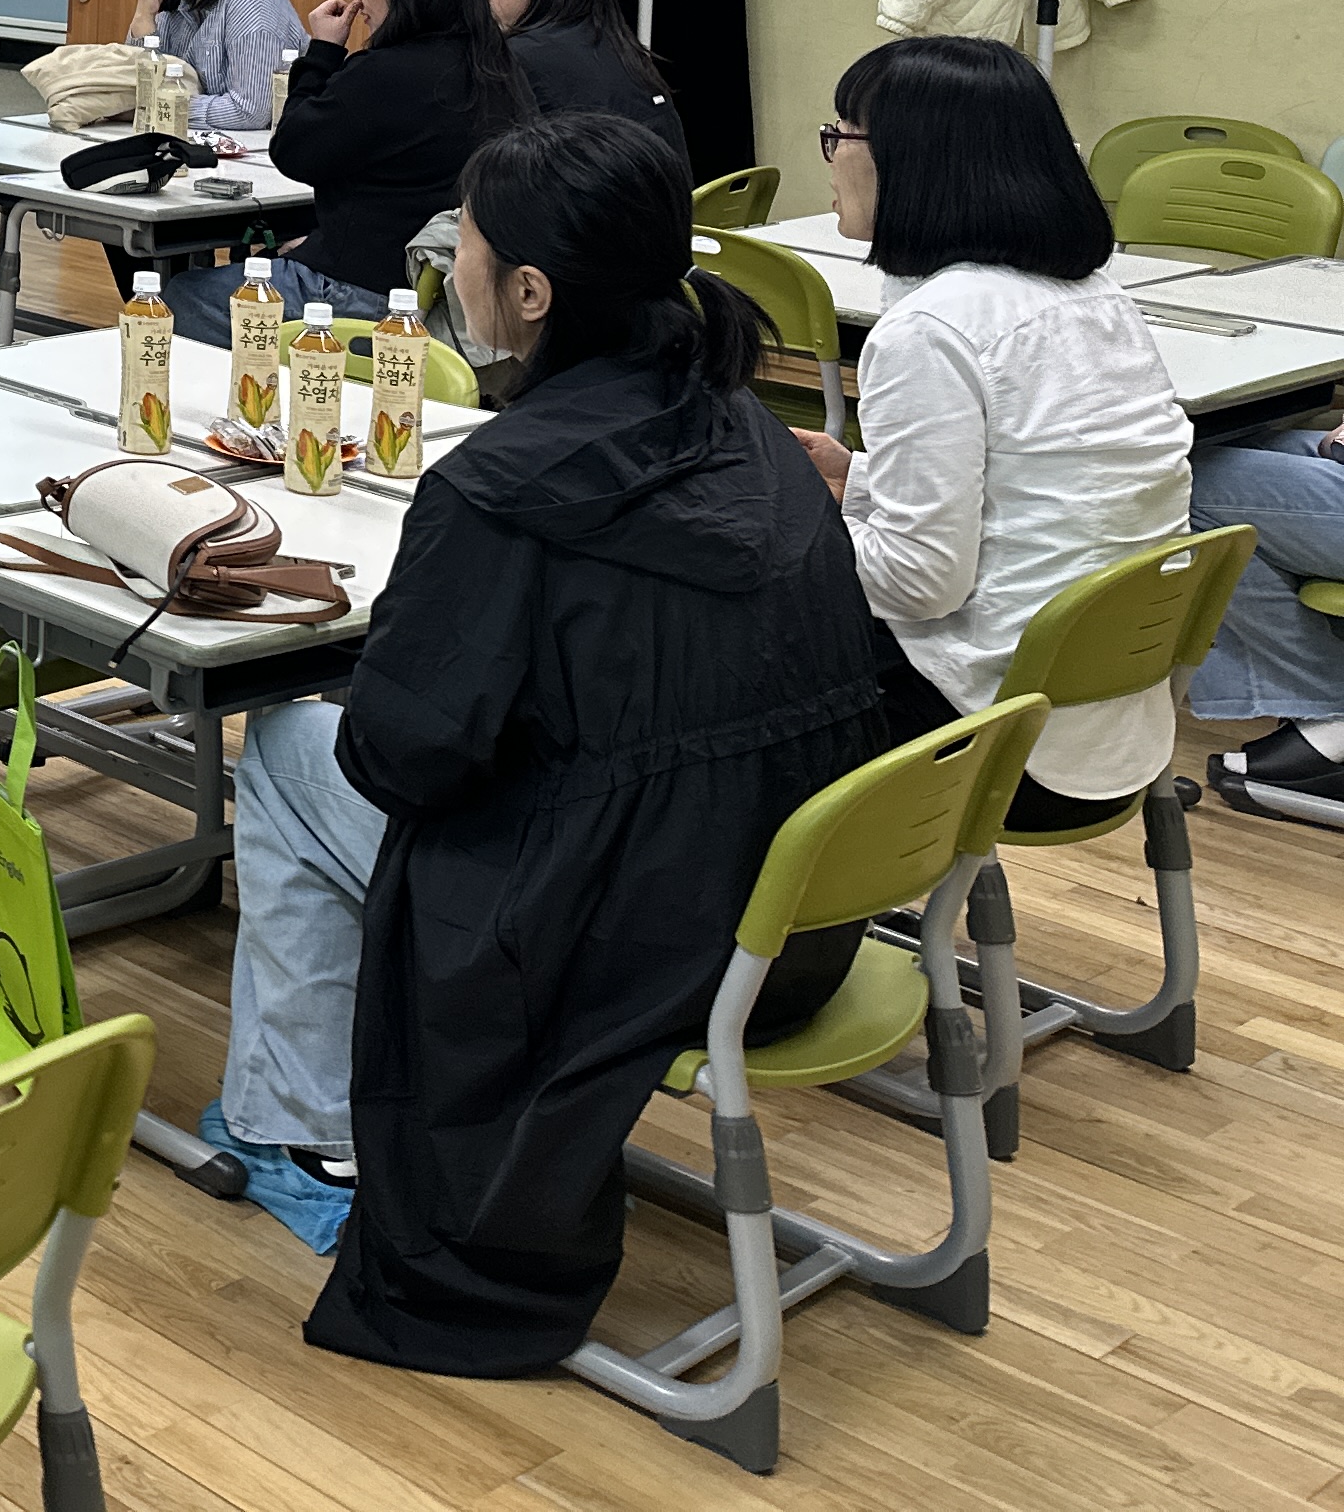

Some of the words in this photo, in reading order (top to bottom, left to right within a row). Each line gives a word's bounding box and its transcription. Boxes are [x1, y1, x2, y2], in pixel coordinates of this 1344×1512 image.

[141, 335, 171, 351] 옥수
[139, 350, 170, 367] 수염
[377, 352, 415, 370] 옥수수
[299, 369, 340, 386] 옥수수
[376, 368, 416, 386] 수염차
[298, 385, 340, 404] 수염차
